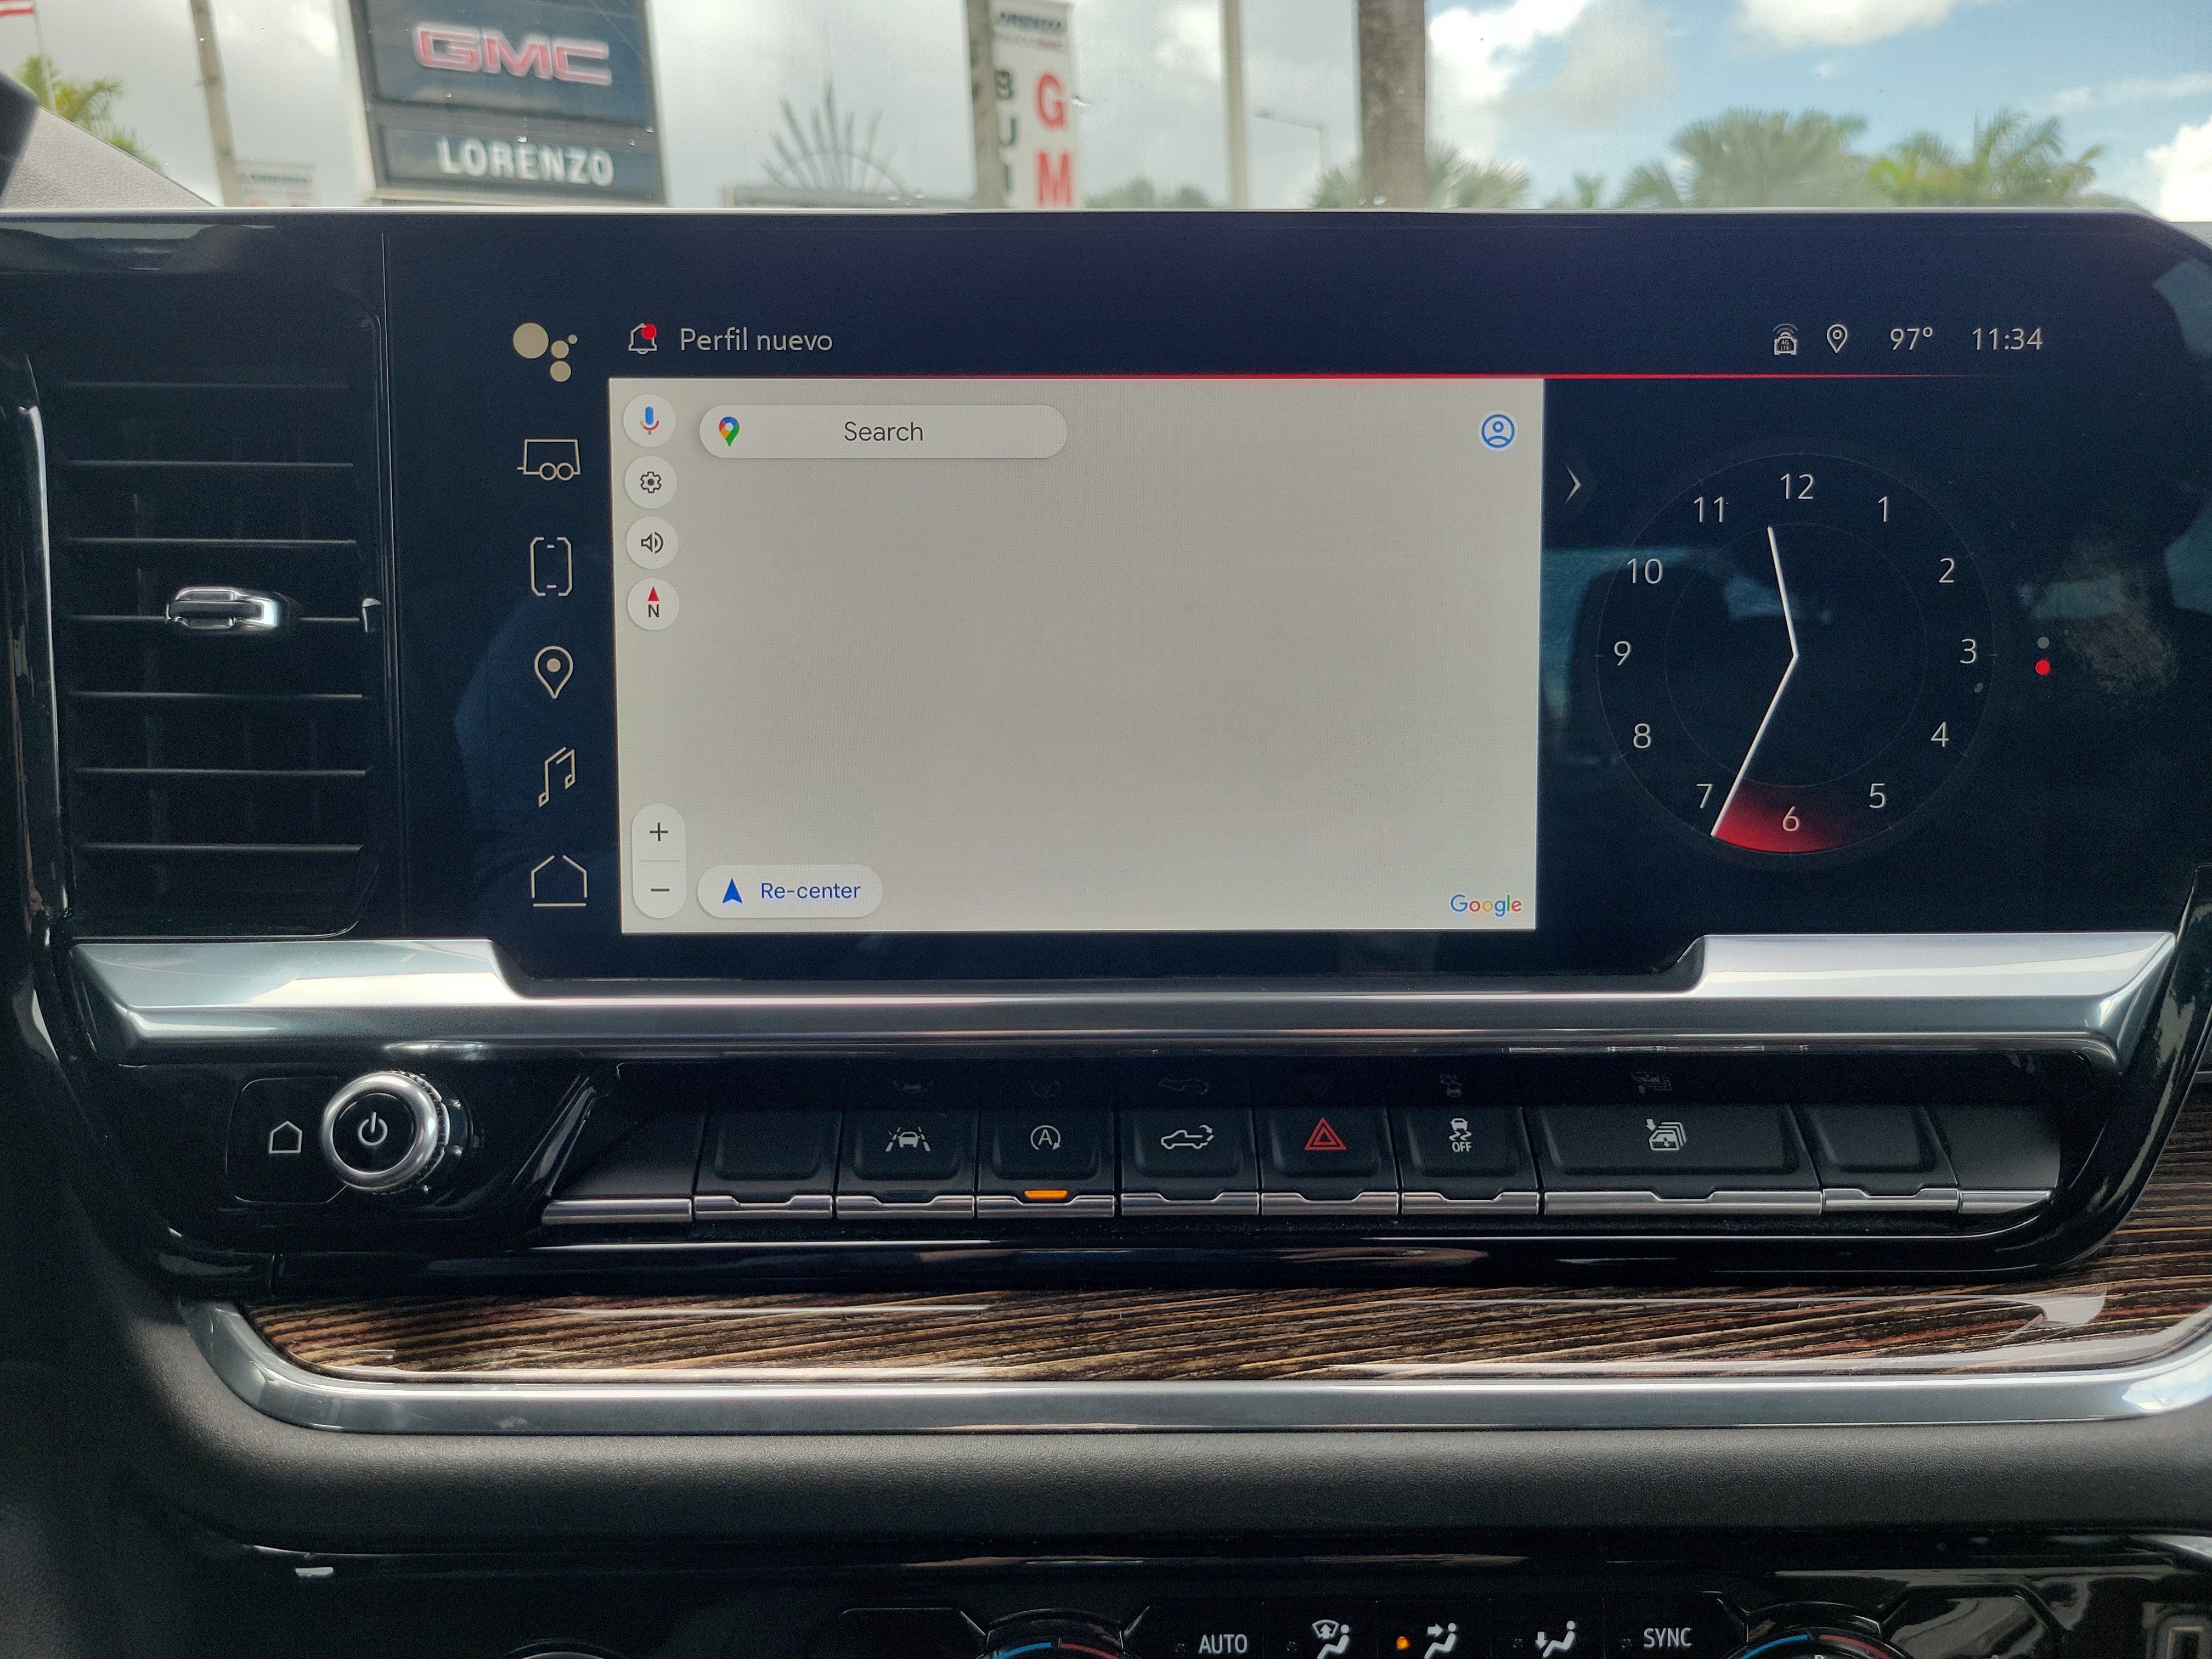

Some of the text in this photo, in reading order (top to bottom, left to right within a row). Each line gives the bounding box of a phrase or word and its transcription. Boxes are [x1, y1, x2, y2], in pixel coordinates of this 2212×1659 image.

[414, 22, 612, 86] GMC
[438, 136, 614, 186] LORENZO
[680, 326, 833, 351] Perfil nuevo
[1890, 327, 1933, 351] 97°
[1972, 328, 2043, 351] 11:34
[844, 421, 923, 442] Search
[1780, 473, 1814, 499] 12
[1692, 496, 1725, 523] 11
[1877, 496, 1888, 522] 1
[1626, 557, 1663, 584] 10
[1938, 557, 1955, 583] 2
[648, 605, 660, 618] N
[1613, 640, 1632, 666] 9
[1960, 638, 1977, 664] 3
[1632, 723, 1652, 749] 8
[1930, 721, 1950, 747] 4
[1696, 783, 1713, 809] 7
[1869, 783, 1886, 809] 5
[1782, 806, 1800, 832] 6
[760, 882, 861, 899] Re-center
[1449, 893, 1522, 918] Google
[1038, 1129, 1053, 1145] A
[1452, 1142, 1472, 1153] OFF
[1198, 1633, 1248, 1654] AUTO
[1644, 1627, 1692, 1648] SYNC
